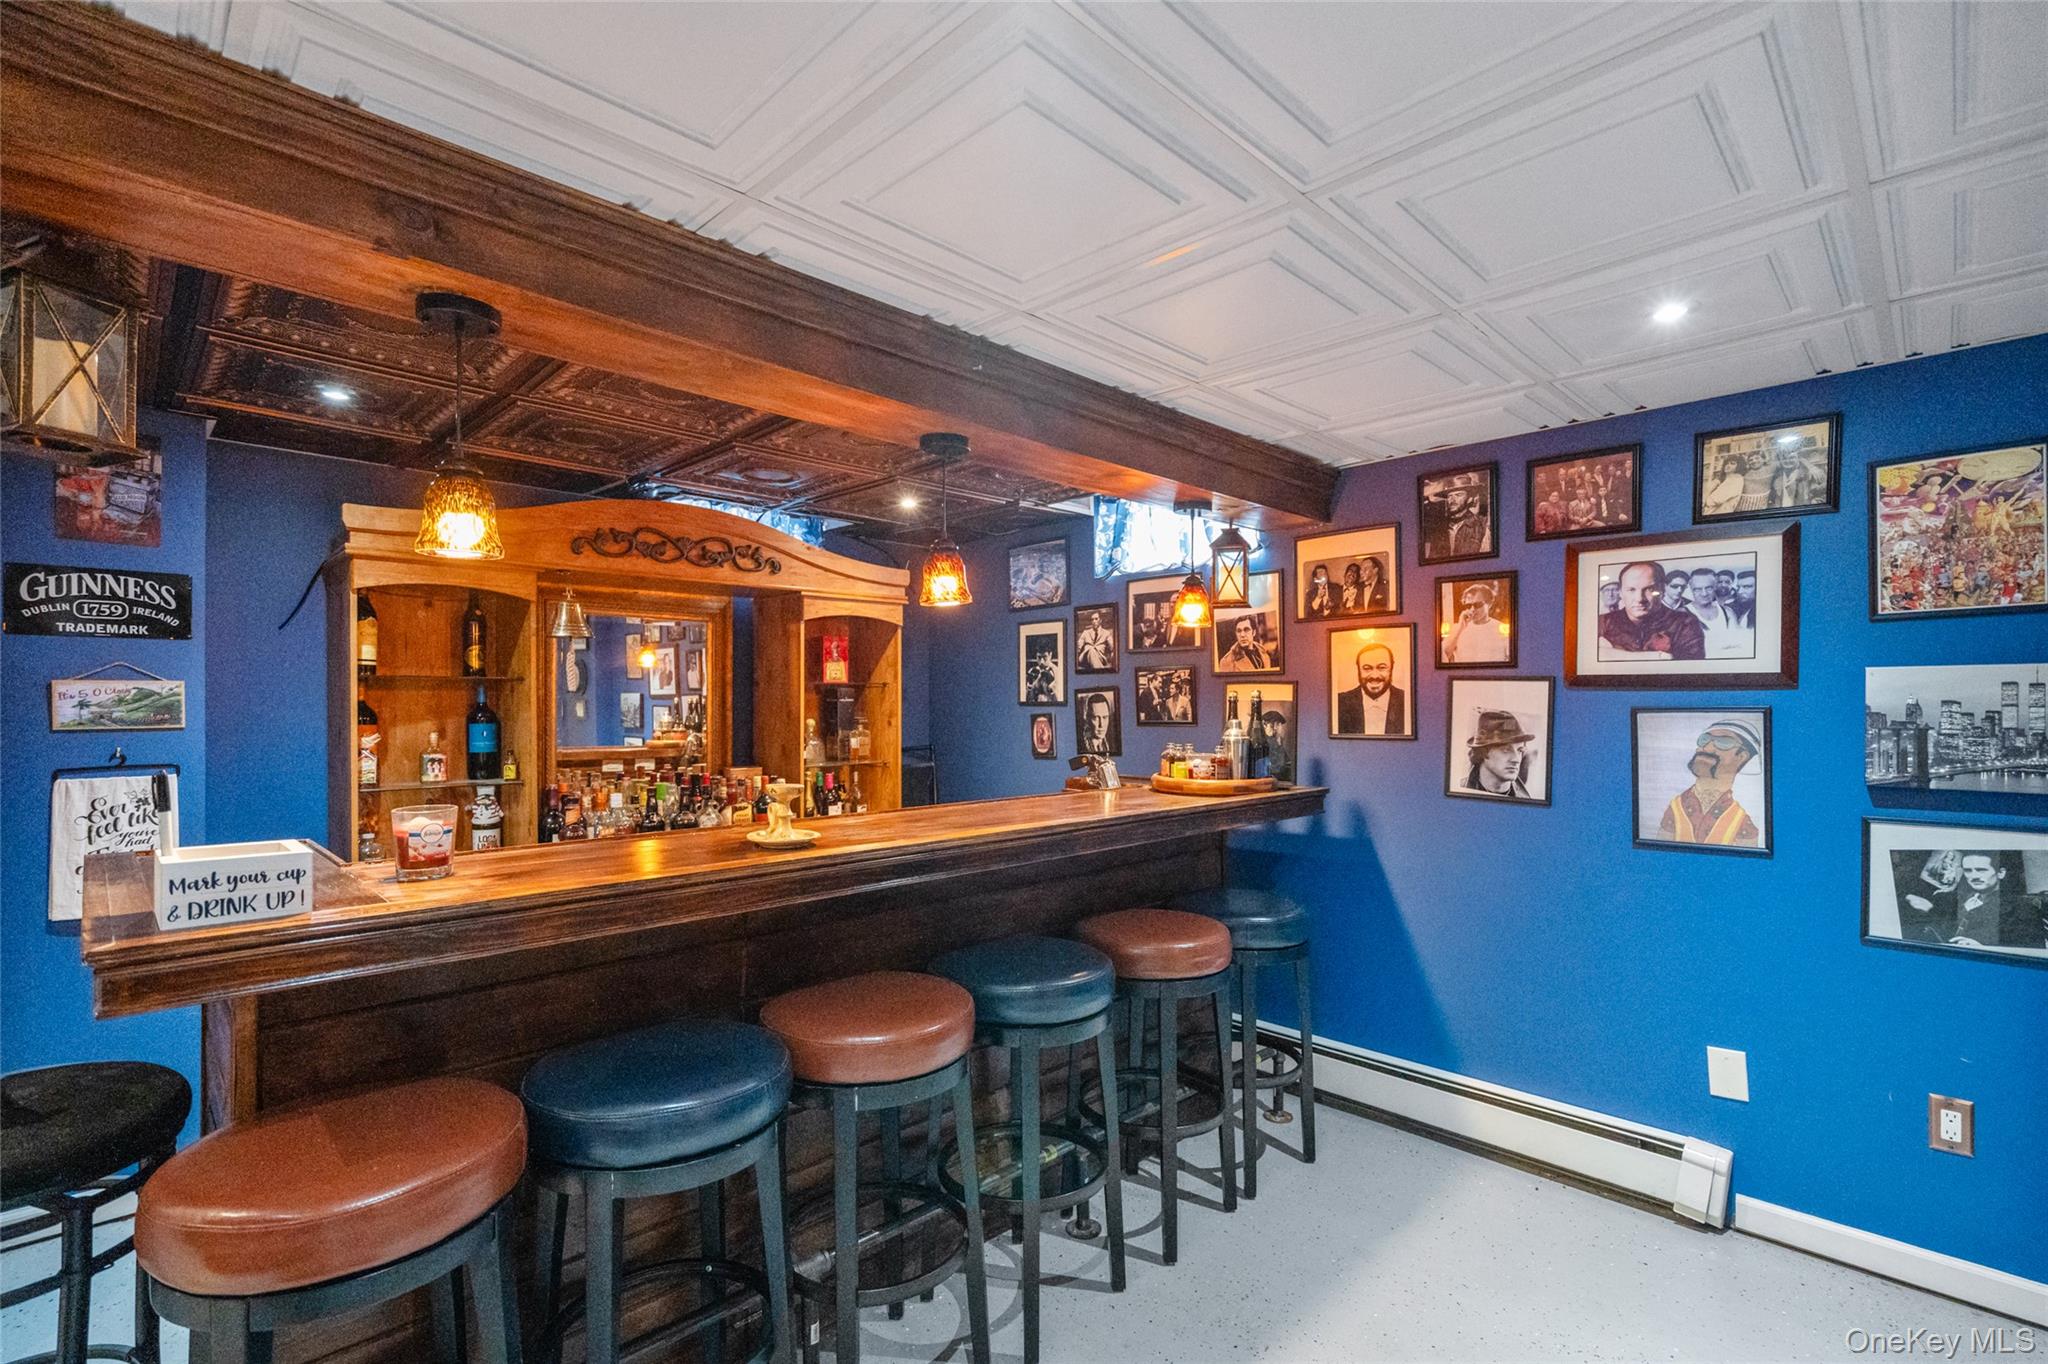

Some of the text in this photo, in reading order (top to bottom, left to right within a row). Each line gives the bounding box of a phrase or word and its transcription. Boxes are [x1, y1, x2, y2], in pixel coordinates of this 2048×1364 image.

[19, 571, 177, 610] GUINNESS
[21, 602, 180, 626] DUBLIN 1759 IRELAND
[56, 622, 149, 635] TRADEMARK
[78, 689, 88, 698] 5
[168, 868, 307, 895] Mark your cup
[167, 904, 181, 922] &
[188, 894, 258, 921] DRINK
